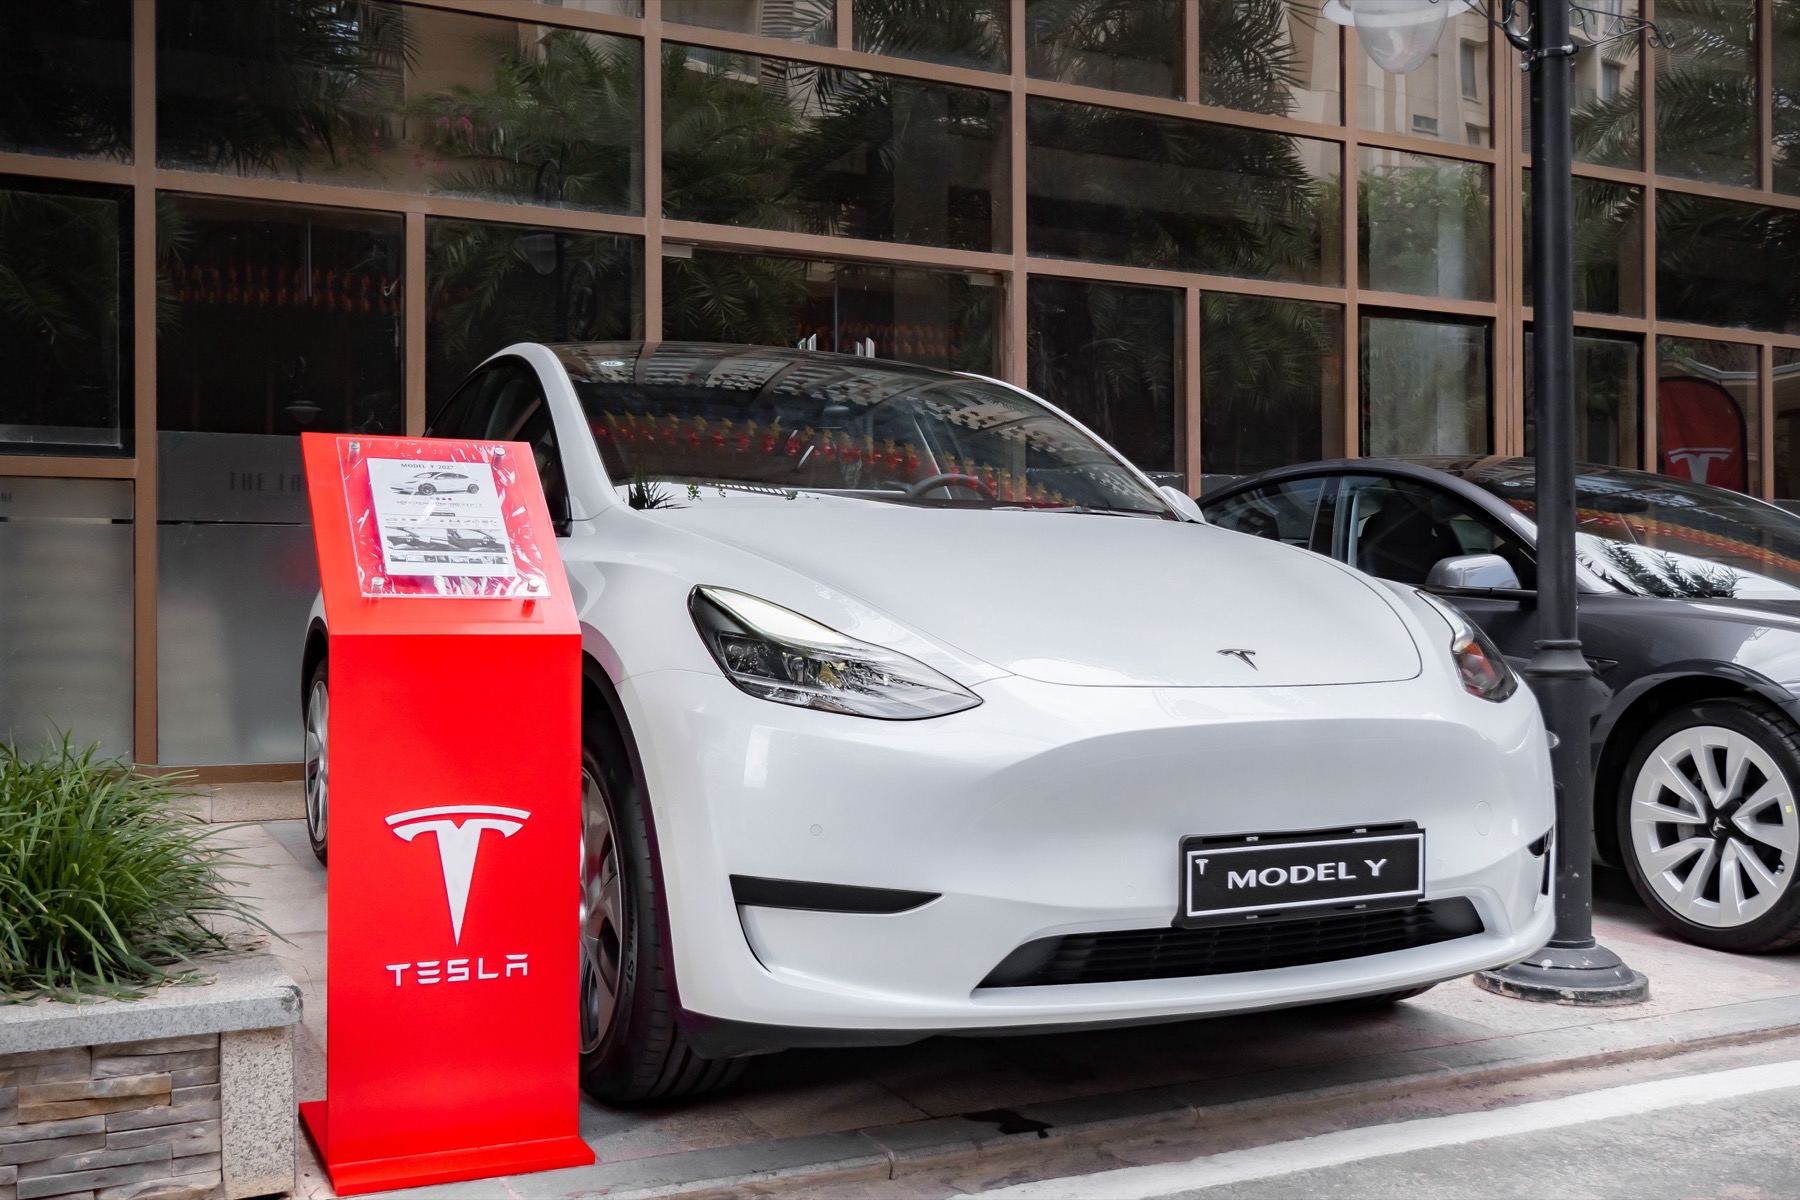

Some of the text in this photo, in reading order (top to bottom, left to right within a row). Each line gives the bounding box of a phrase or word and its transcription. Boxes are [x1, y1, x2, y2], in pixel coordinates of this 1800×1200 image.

[1227, 858, 1387, 890] MODEL Y
[385, 953, 529, 987] TESLA
